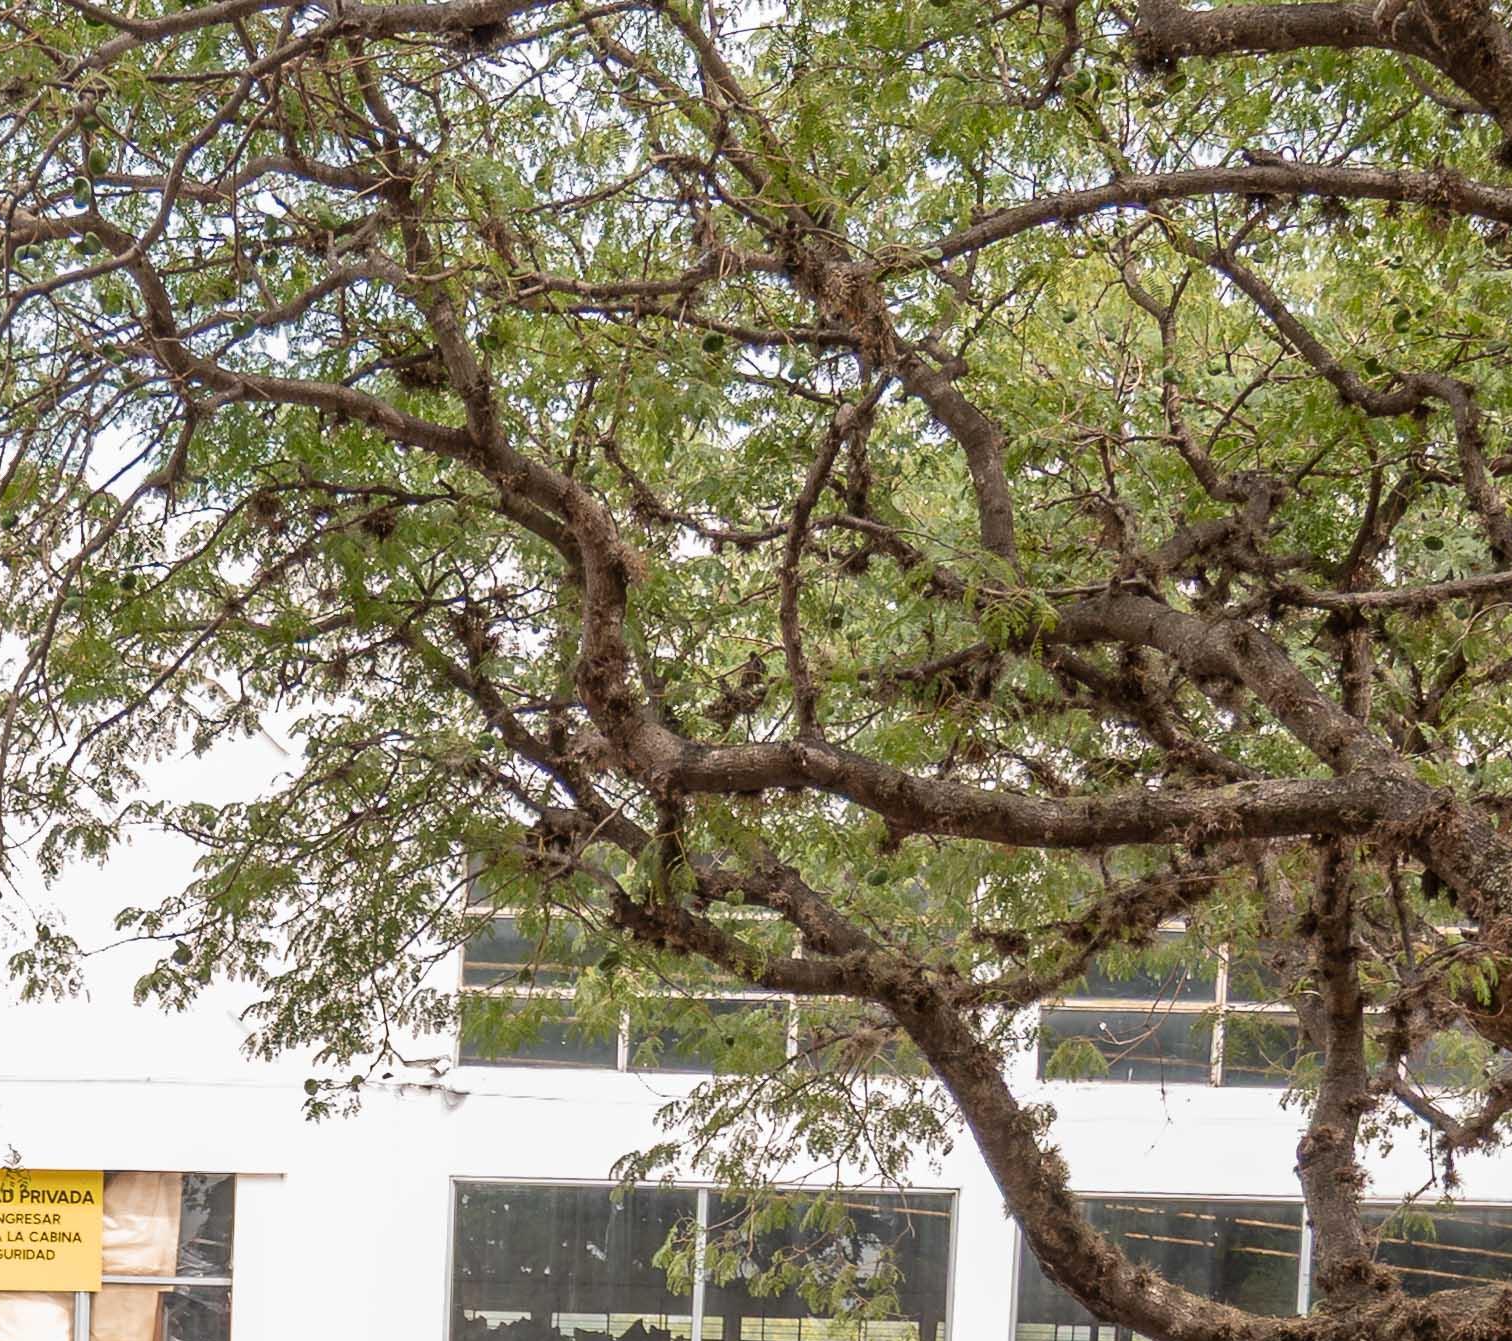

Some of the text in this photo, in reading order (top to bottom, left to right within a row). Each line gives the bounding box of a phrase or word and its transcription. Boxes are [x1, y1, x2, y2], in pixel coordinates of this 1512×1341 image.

[20, 1189, 95, 1205] PRIVADA
[7, 1231, 24, 1242] LA
[29, 1231, 82, 1243] CABINA
